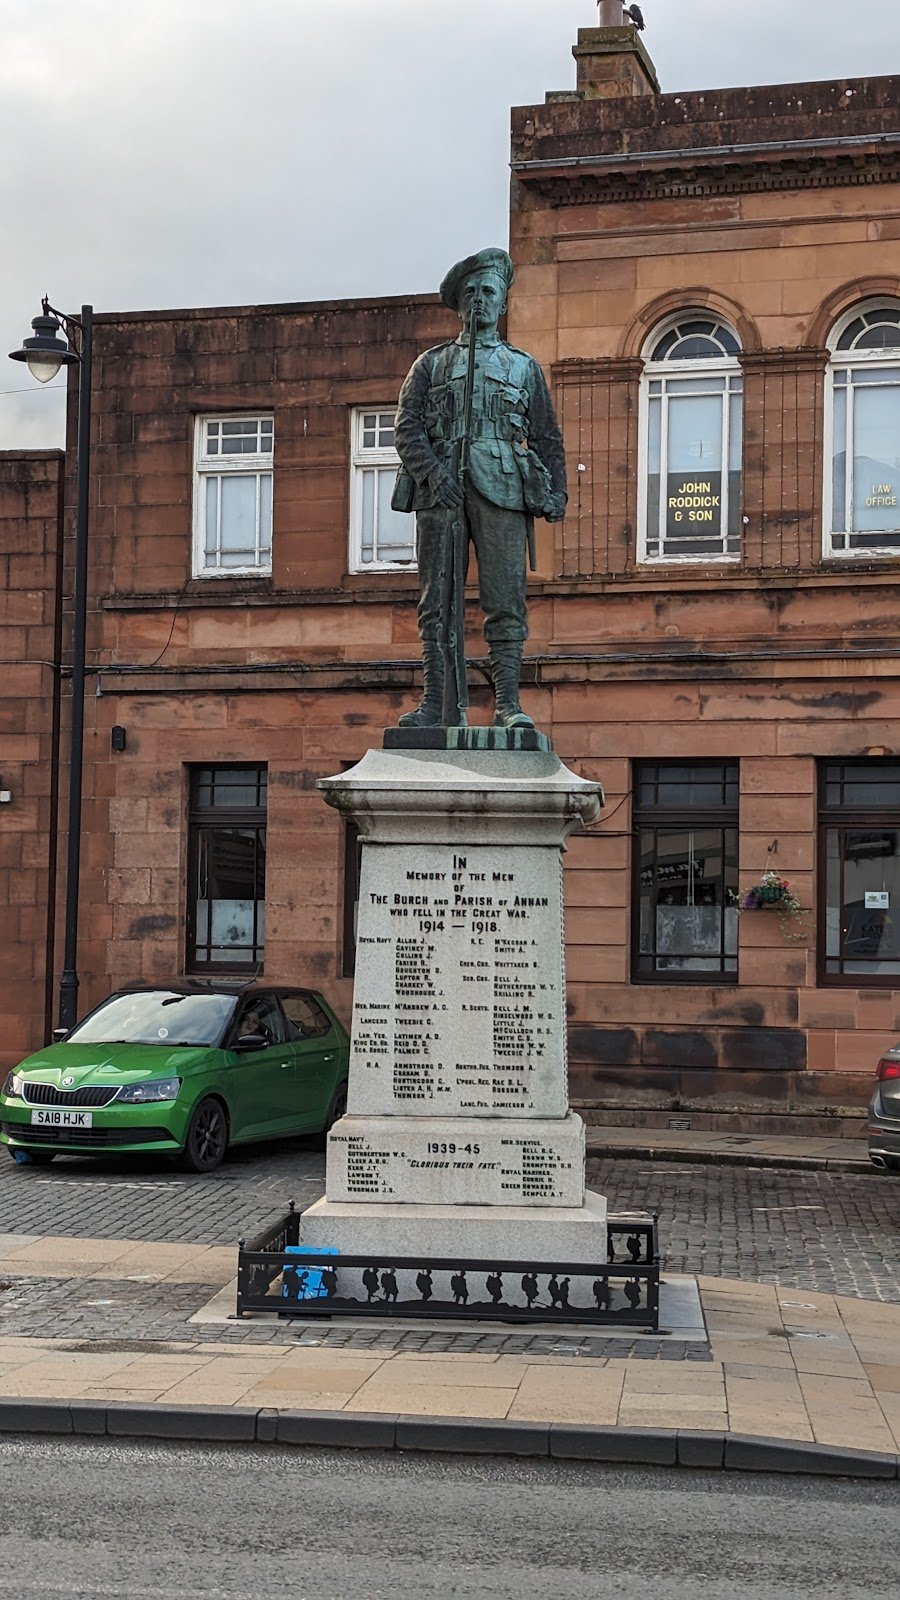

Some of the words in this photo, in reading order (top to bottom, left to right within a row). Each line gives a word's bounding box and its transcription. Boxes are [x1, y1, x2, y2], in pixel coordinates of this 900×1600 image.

[678, 482, 711, 494] JOHN
[872, 485, 891, 494] LAW
[669, 496, 720, 508] RODDICK
[866, 496, 897, 506] OFFICE
[675, 511, 683, 522] &
[689, 511, 712, 521] SON
[453, 855, 467, 869] IN
[407, 871, 446, 880] MEMORY
[492, 872, 514, 881] MEN
[370, 894, 388, 904] THE
[455, 895, 492, 906] PARISH
[514, 896, 548, 907] ANNAN
[390, 909, 408, 917] WHO
[413, 909, 432, 917] FELL
[436, 909, 445, 917] IN
[451, 909, 467, 917] THE
[507, 909, 530, 919] WAR.
[419, 921, 445, 933] 1914
[472, 922, 501, 934] 1918.
[38, 1112, 61, 1124] SA18
[64, 1113, 86, 1125] HJK
